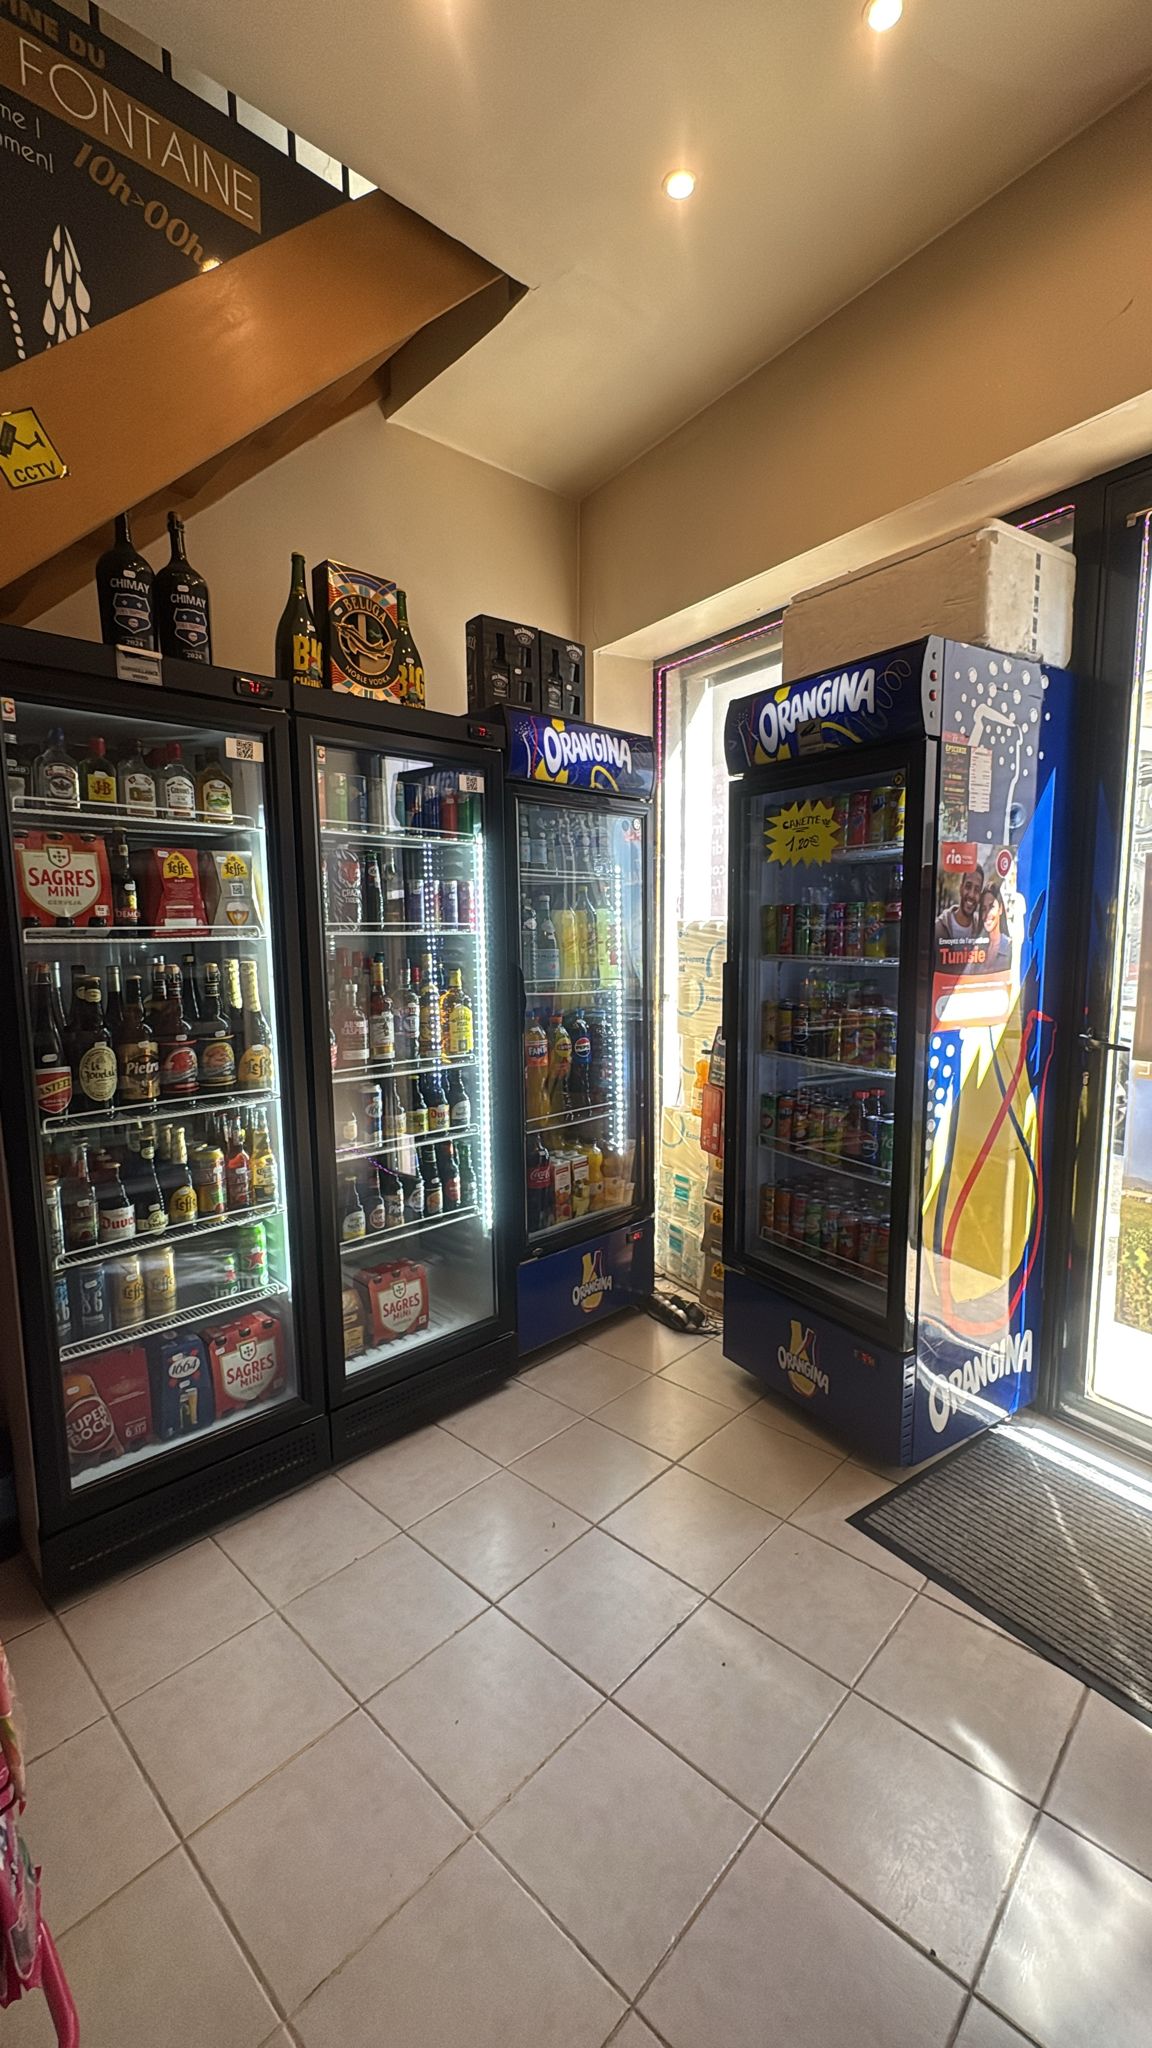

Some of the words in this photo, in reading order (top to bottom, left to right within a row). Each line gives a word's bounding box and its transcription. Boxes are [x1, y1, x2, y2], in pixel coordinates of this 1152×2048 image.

[0, 0, 60, 42] INE
[68, 30, 106, 69] DU
[18, 37, 254, 220] FONTAINE
[14, 461, 58, 483] CCTV
[110, 577, 150, 595] CHIMAY
[170, 593, 206, 609] CHIMAY
[343, 598, 387, 624] BELUGA
[345, 665, 367, 684] NOBLE
[368, 674, 391, 686] VODKA
[758, 668, 875, 753] ORANGINA
[543, 726, 632, 774] ORANGINA
[946, 849, 961, 864] ria
[28, 867, 96, 888] SAGRES
[167, 861, 189, 875] Leffe
[224, 862, 244, 876] Leffe
[48, 886, 80, 897] MINI
[940, 945, 986, 964] Tunisie
[100, 1216, 135, 1230] Duve
[572, 1275, 612, 1306] ORANGINA
[383, 1293, 420, 1317] SAGRES
[171, 1358, 197, 1376] 1664
[226, 1353, 274, 1385] SAGRES
[777, 1345, 829, 1395] ORANGINA
[240, 1373, 263, 1388] MINI
[928, 1329, 1033, 1434] ORANGINA
[66, 1405, 107, 1438] SUPER
[71, 1416, 111, 1447] BOCK
